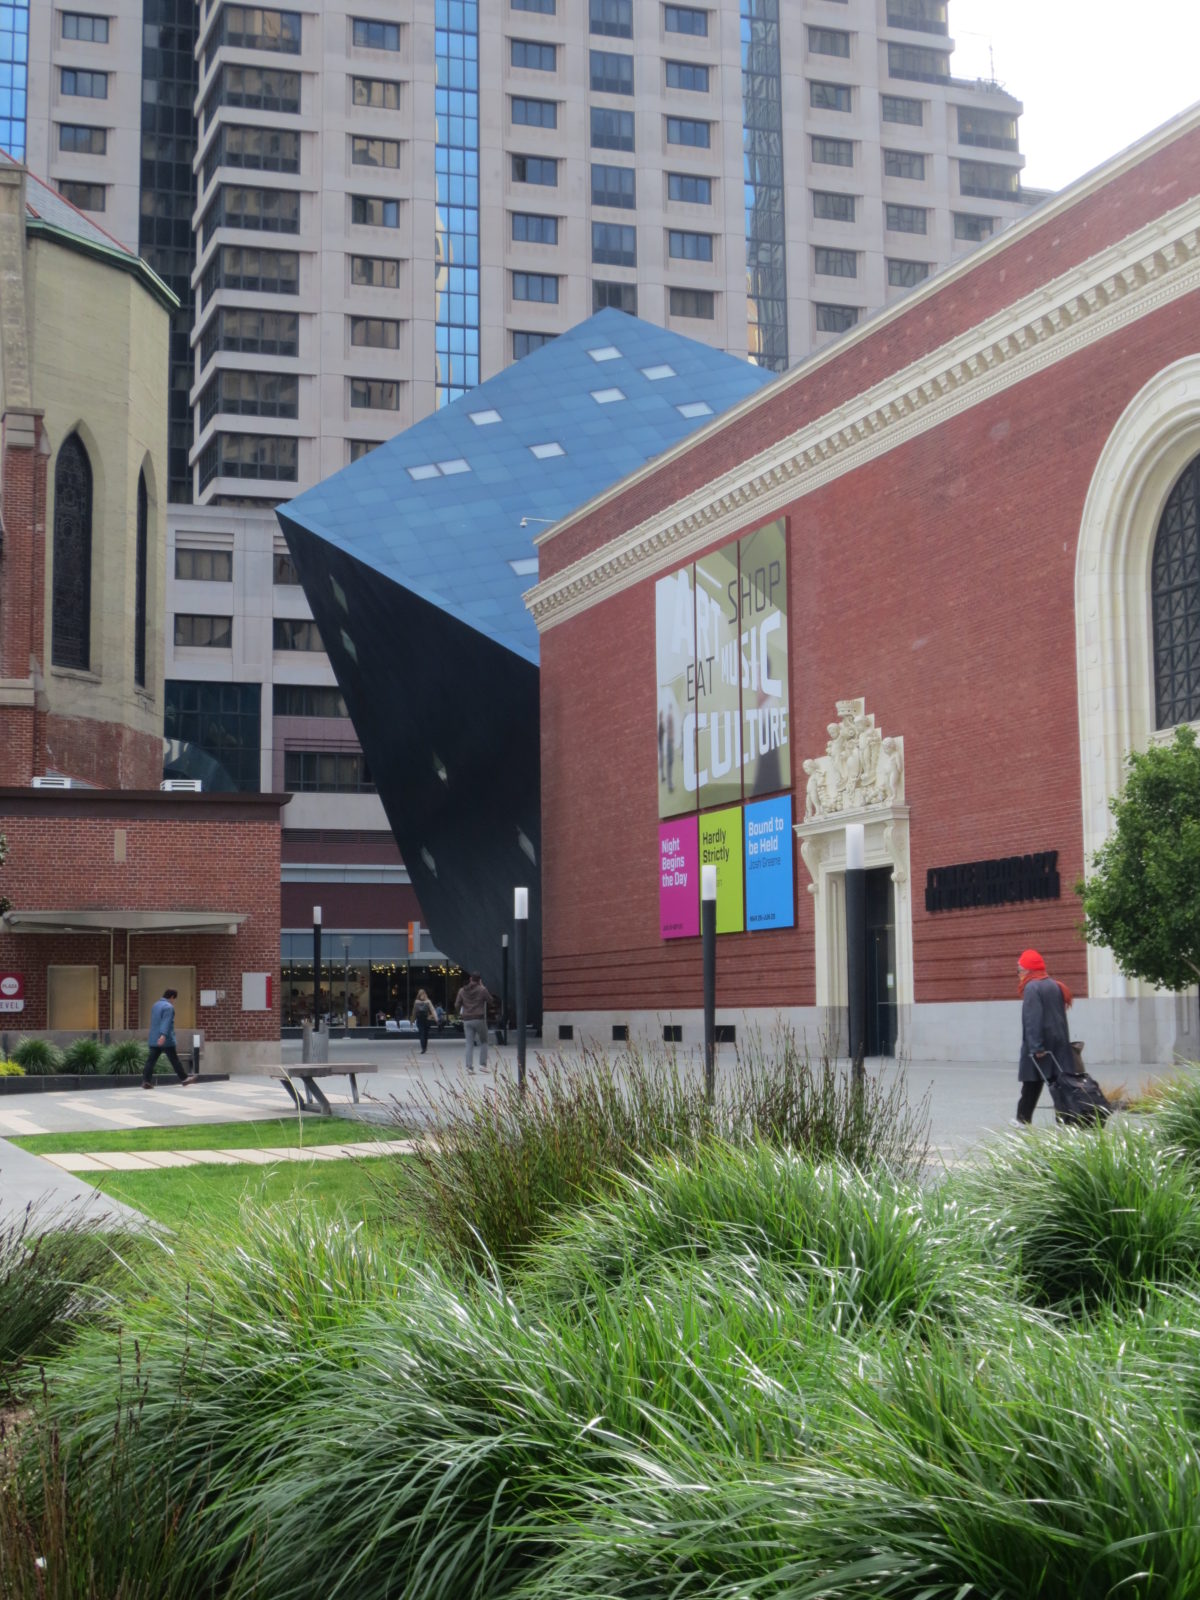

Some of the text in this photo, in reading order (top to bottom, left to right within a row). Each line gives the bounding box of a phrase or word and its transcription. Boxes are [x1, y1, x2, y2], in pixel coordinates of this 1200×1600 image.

[728, 560, 780, 625] SHOP
[721, 610, 782, 698] MUSIC
[687, 655, 715, 702] EAT
[683, 707, 788, 792] CULTURE
[748, 817, 784, 837] Bound to
[662, 839, 680, 856] Night
[703, 829, 727, 846] Hardly
[748, 836, 778, 856] be Held
[662, 857, 685, 873] Begins
[703, 847, 729, 863] Strictly
[662, 871, 688, 888] the Day
